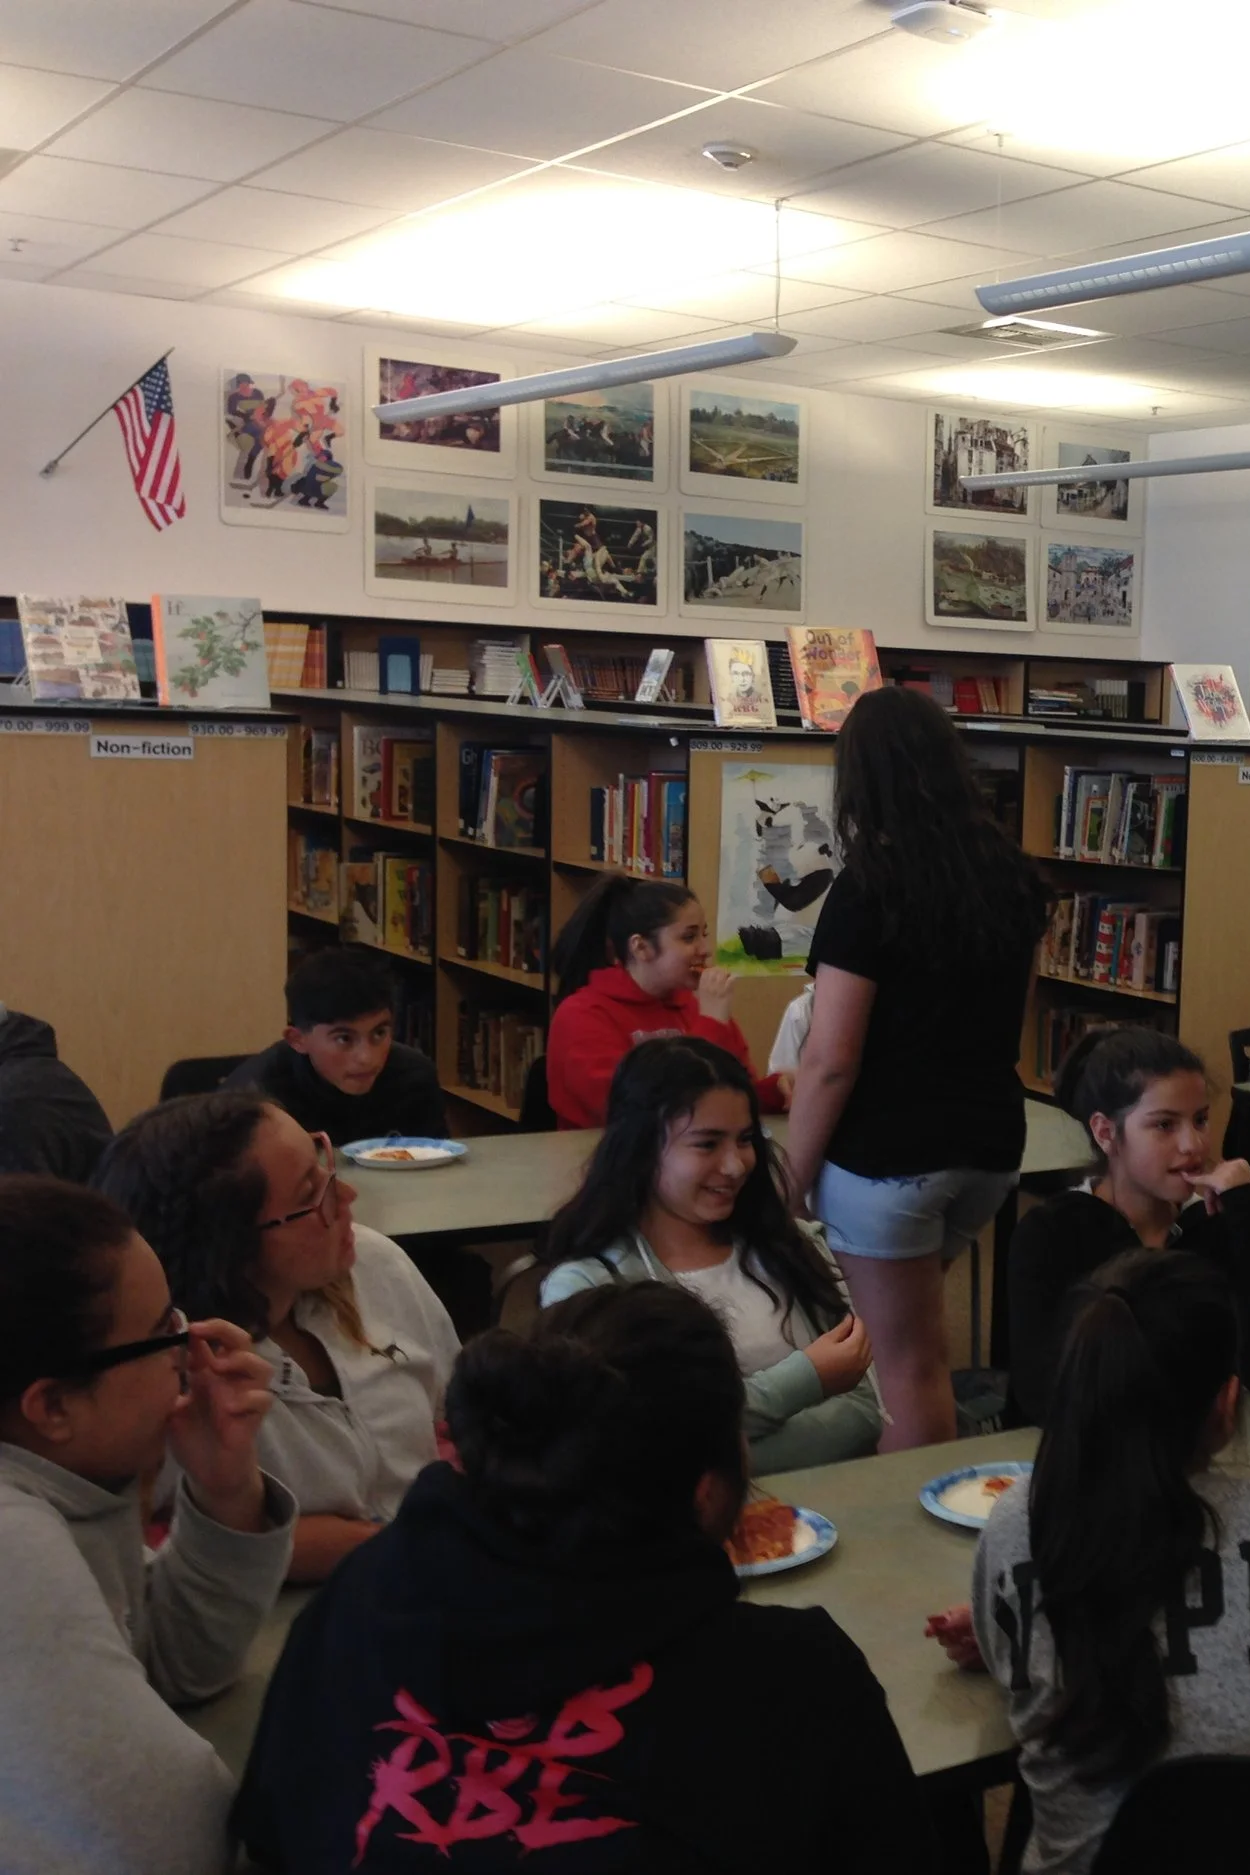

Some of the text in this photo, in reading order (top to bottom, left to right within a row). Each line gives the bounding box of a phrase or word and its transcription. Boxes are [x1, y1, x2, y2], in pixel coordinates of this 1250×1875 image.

[806, 629, 855, 645] Out of
[804, 645, 862, 661] Wonder
[96, 739, 193, 757] Non-fiction
